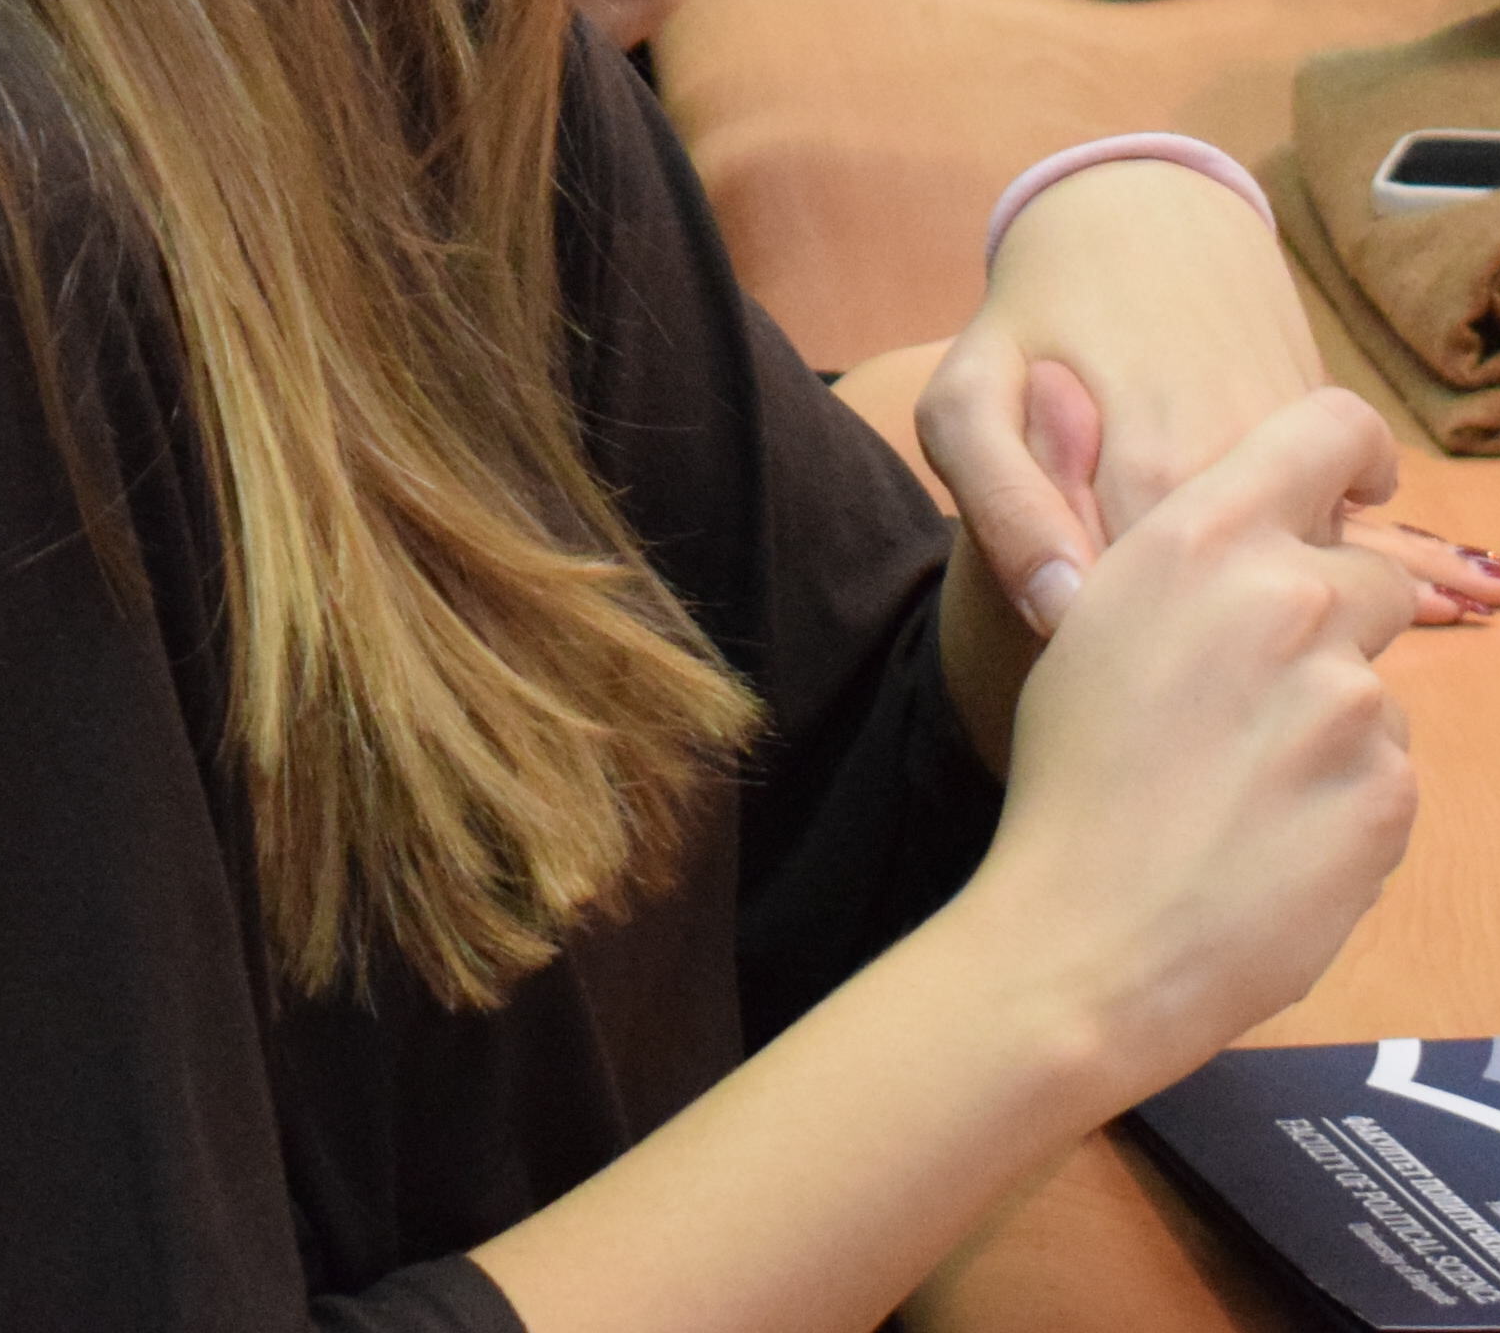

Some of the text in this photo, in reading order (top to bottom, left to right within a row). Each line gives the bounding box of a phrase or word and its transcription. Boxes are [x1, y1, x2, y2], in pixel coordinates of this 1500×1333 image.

[1275, 1118, 1360, 1172] FACULTY
[1335, 1171, 1379, 1191] OF
[1352, 1190, 1448, 1255] POLITICAL
